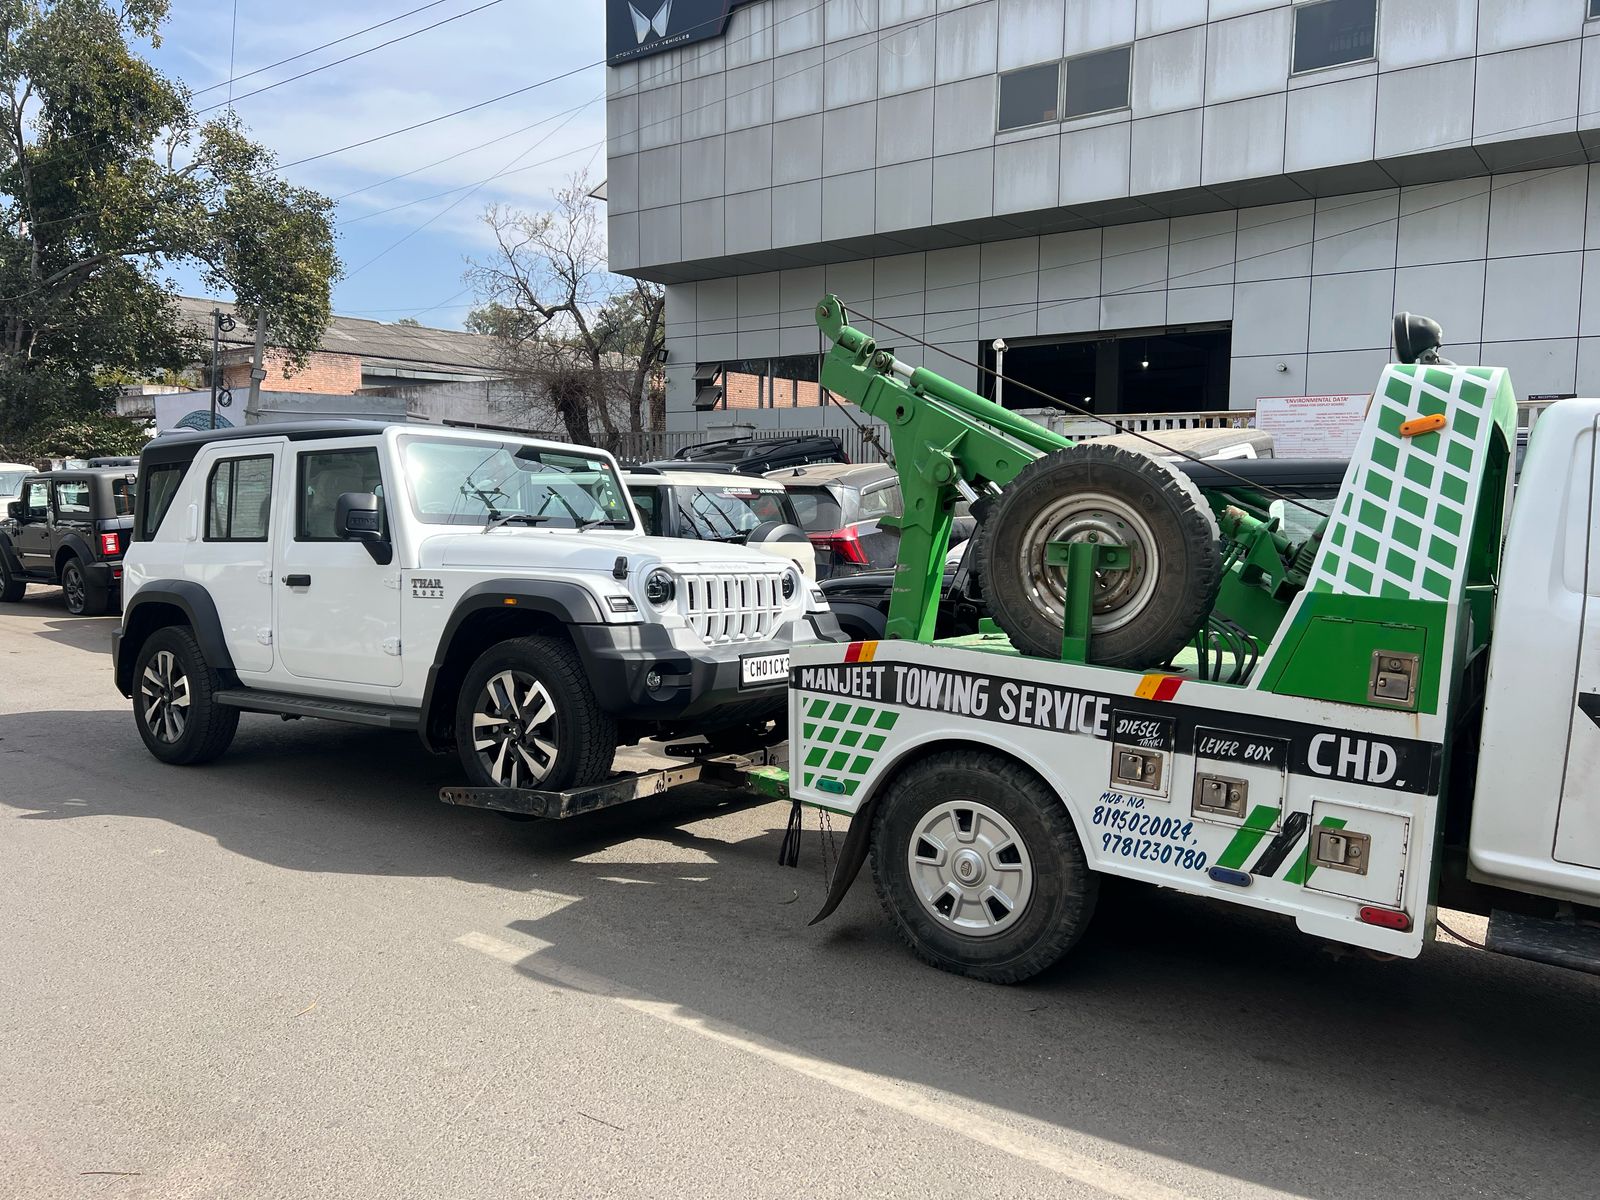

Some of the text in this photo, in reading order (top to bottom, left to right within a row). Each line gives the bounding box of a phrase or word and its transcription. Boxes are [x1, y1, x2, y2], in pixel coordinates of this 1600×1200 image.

[636, 43, 659, 53] UTILITY
[662, 34, 690, 45] VEHICLES
[411, 578, 444, 589] THAR
[801, 666, 1111, 737] MANJEET TOWING SERVICE
[1116, 719, 1160, 738] DIESEL
[1199, 736, 1275, 762] LEVER BOX
[1307, 732, 1406, 787] CHD.
[1127, 796, 1145, 810] NO.
